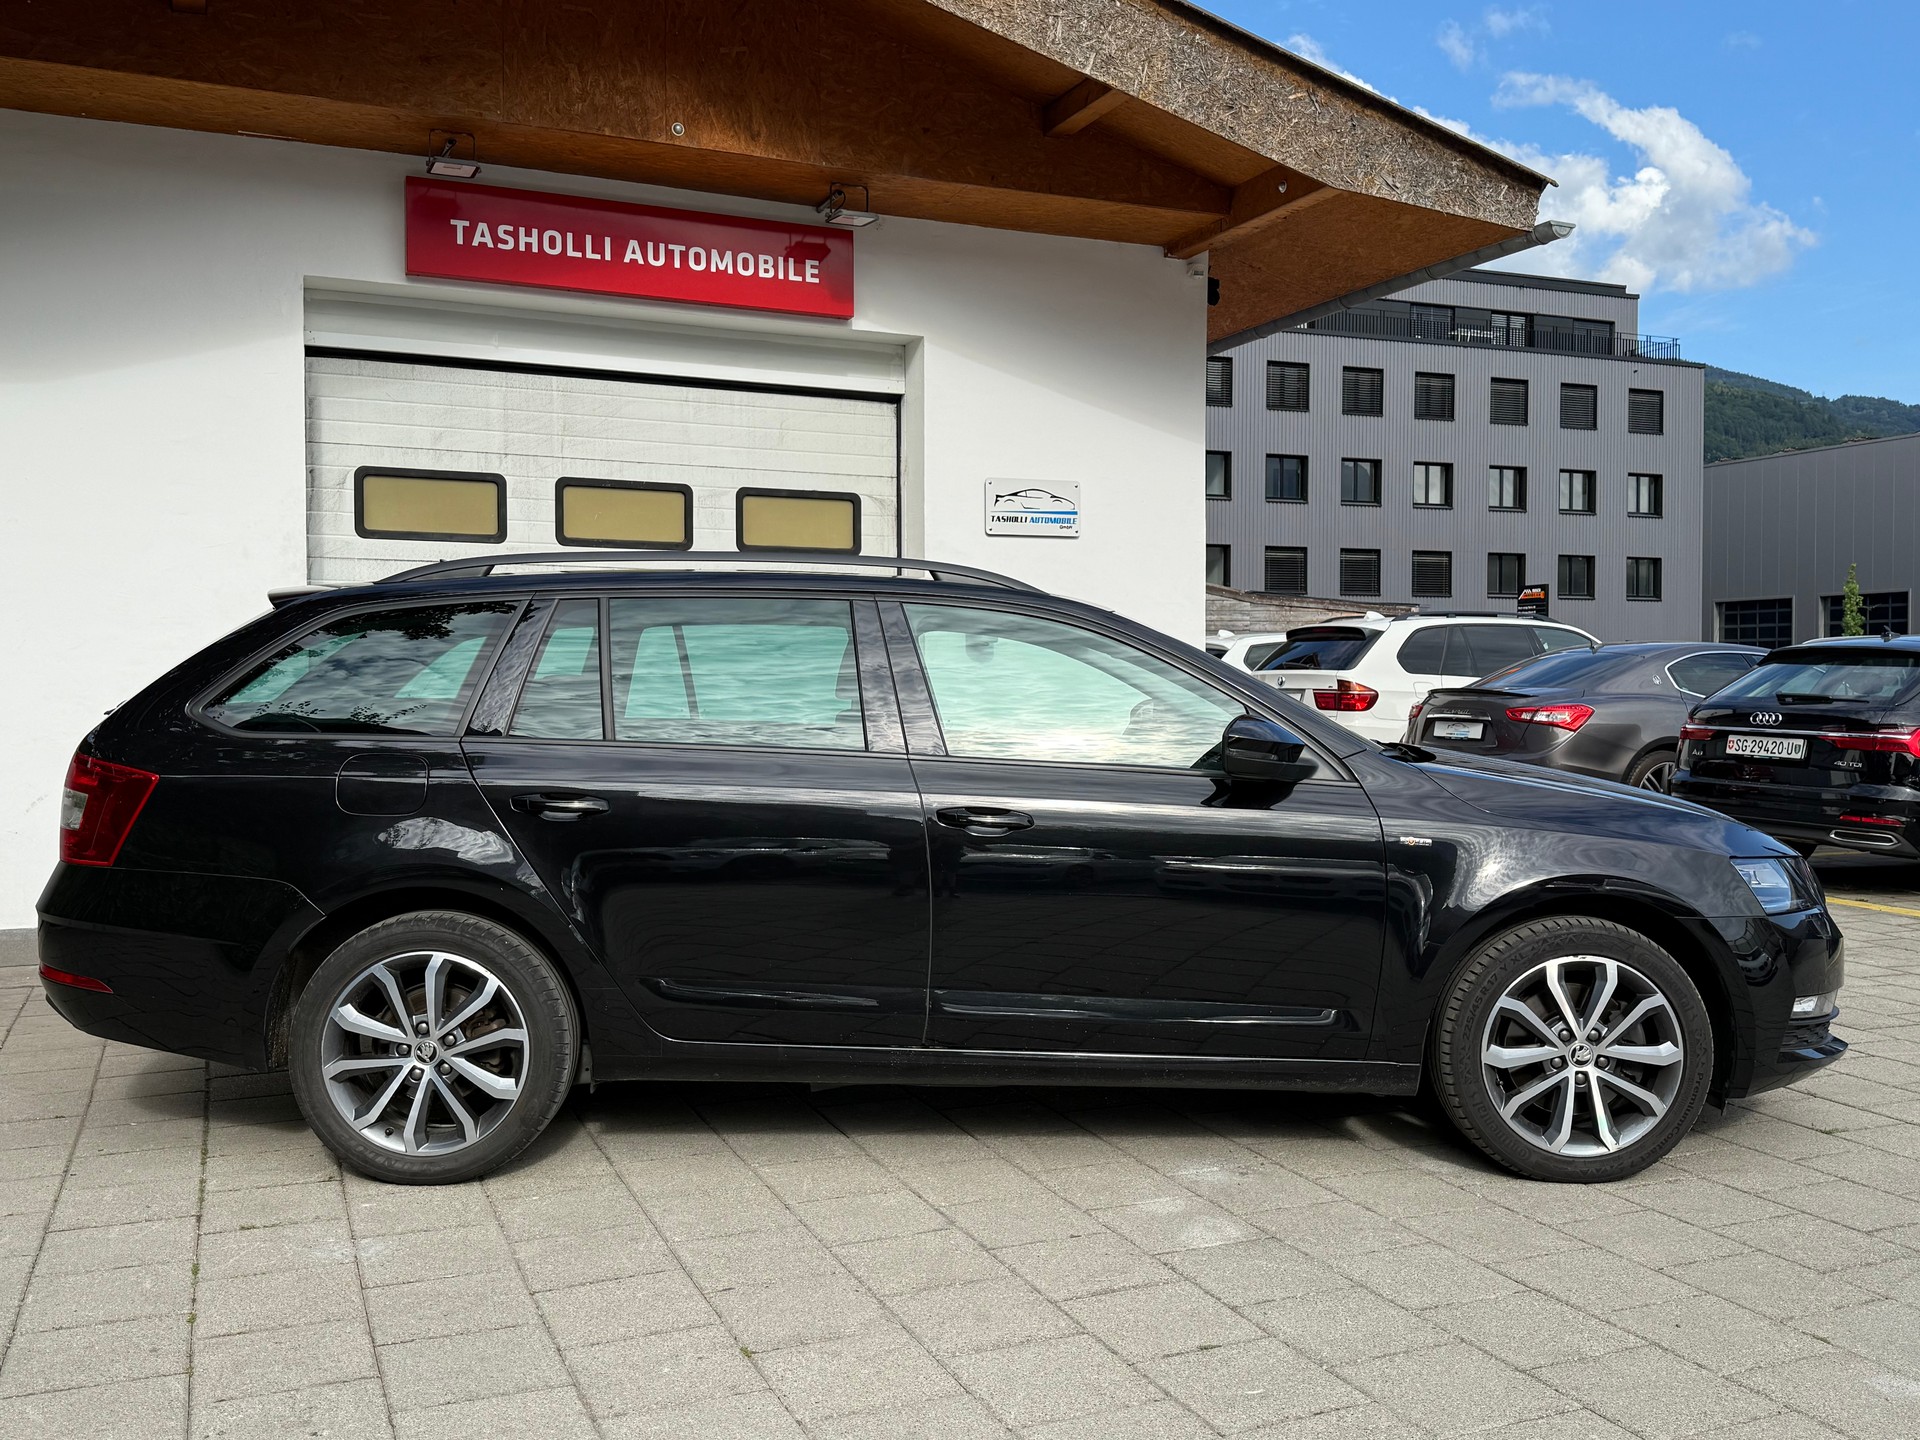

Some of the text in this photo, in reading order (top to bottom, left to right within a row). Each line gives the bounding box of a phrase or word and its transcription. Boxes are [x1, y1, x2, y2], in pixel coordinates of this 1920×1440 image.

[450, 219, 820, 284] TASHOLLI AUTOMOBILE
[990, 515, 1078, 525] TASHOLLI AUTOMOBILE
